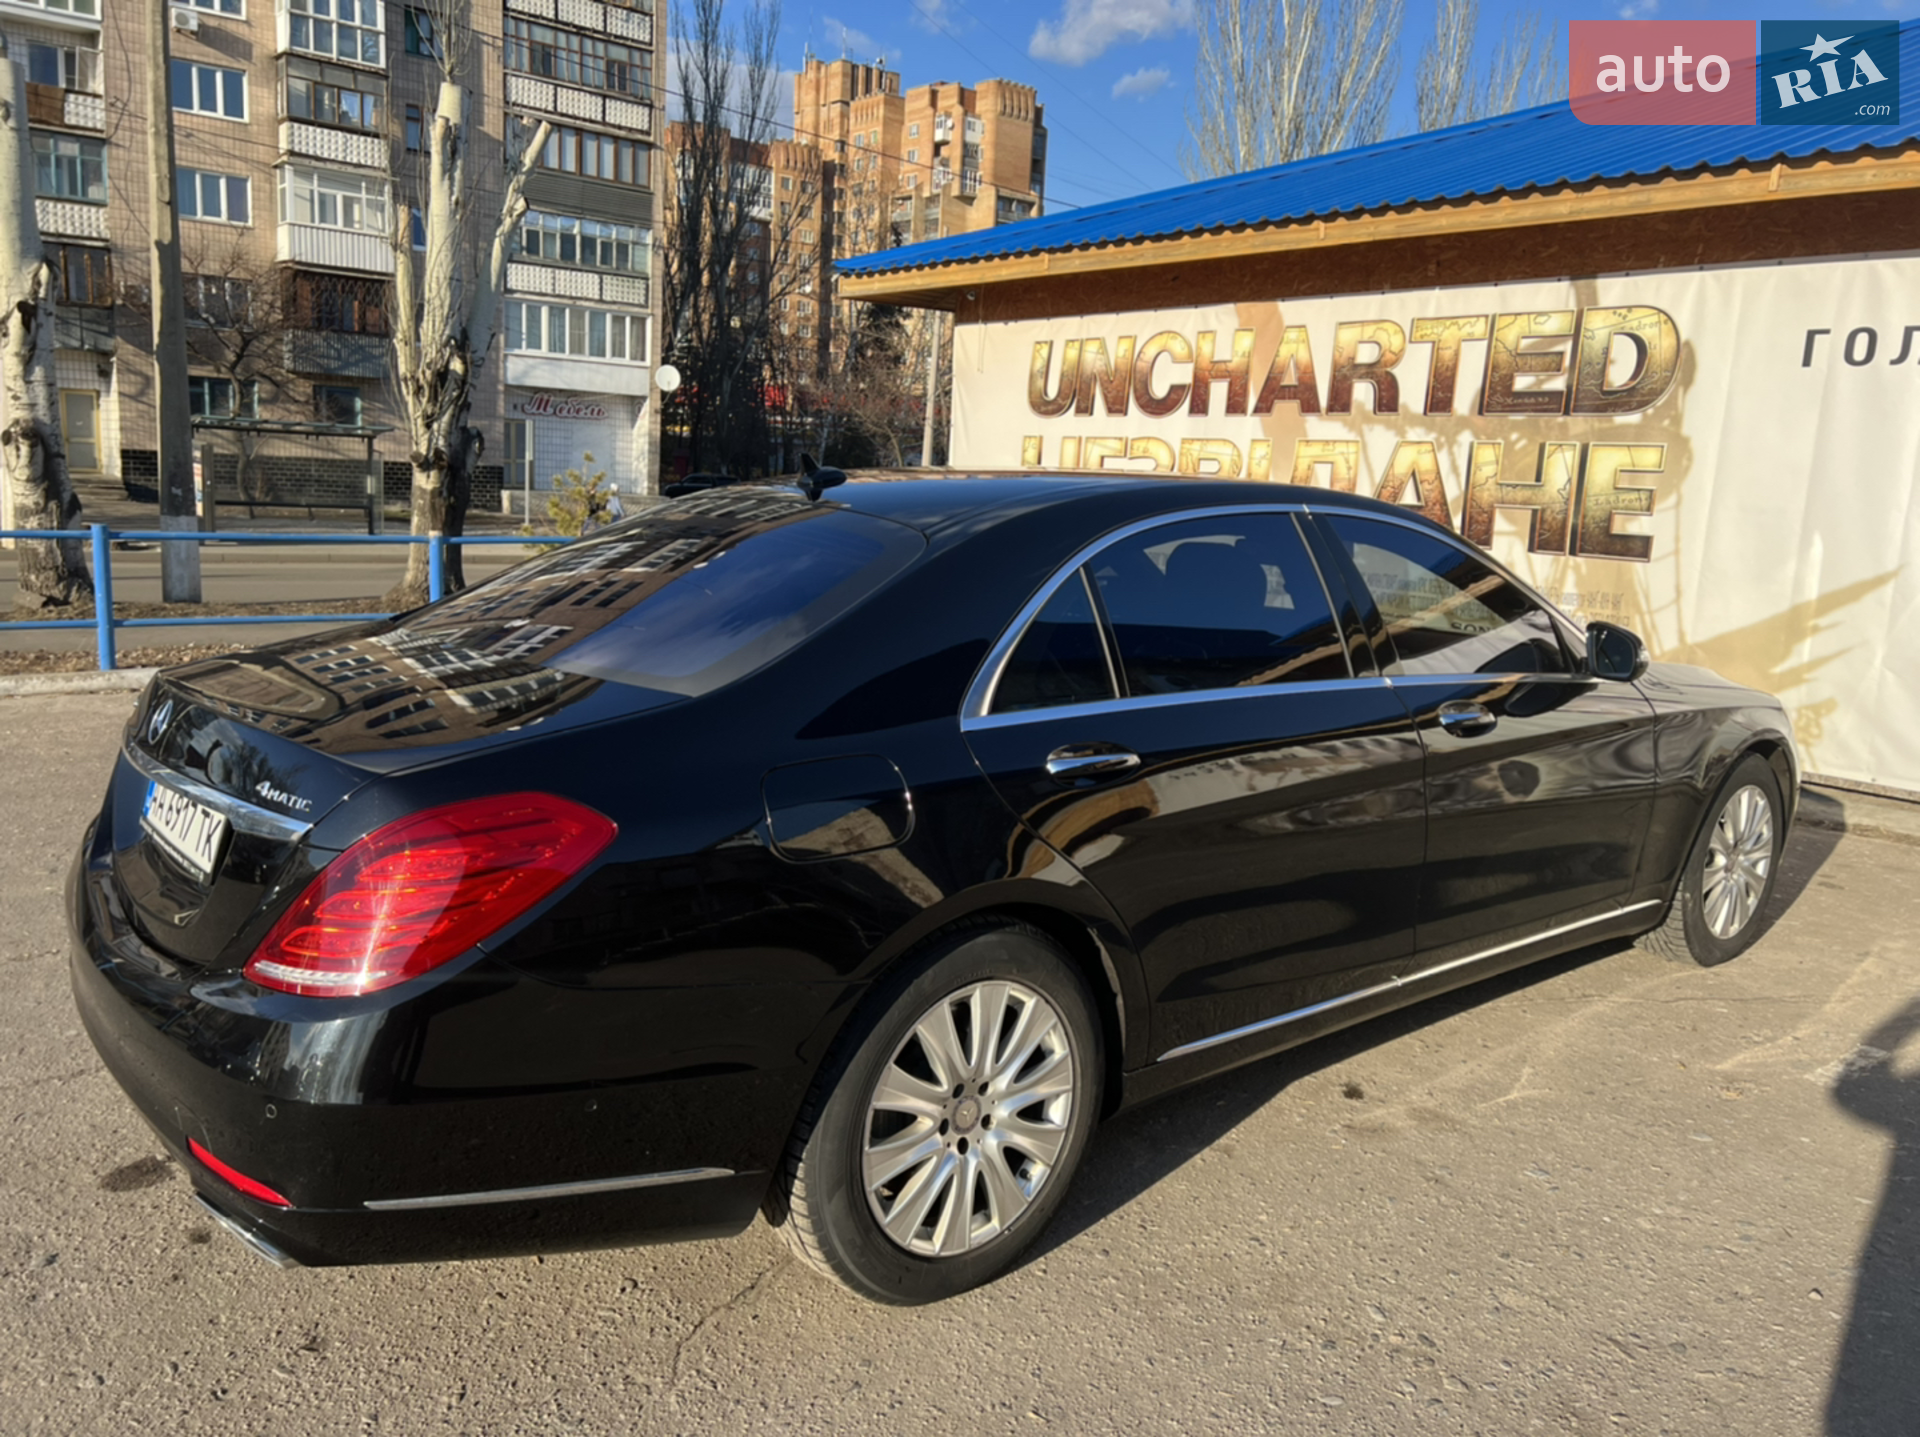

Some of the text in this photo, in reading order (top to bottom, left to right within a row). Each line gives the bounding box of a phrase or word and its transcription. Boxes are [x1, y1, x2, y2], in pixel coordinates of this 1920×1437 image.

[1027, 305, 1682, 419] UNCHARTED
[523, 391, 608, 420] Мебель
[255, 780, 313, 813] 4MATIC
[165, 792, 198, 842] 6917
[196, 807, 222, 863] TK
